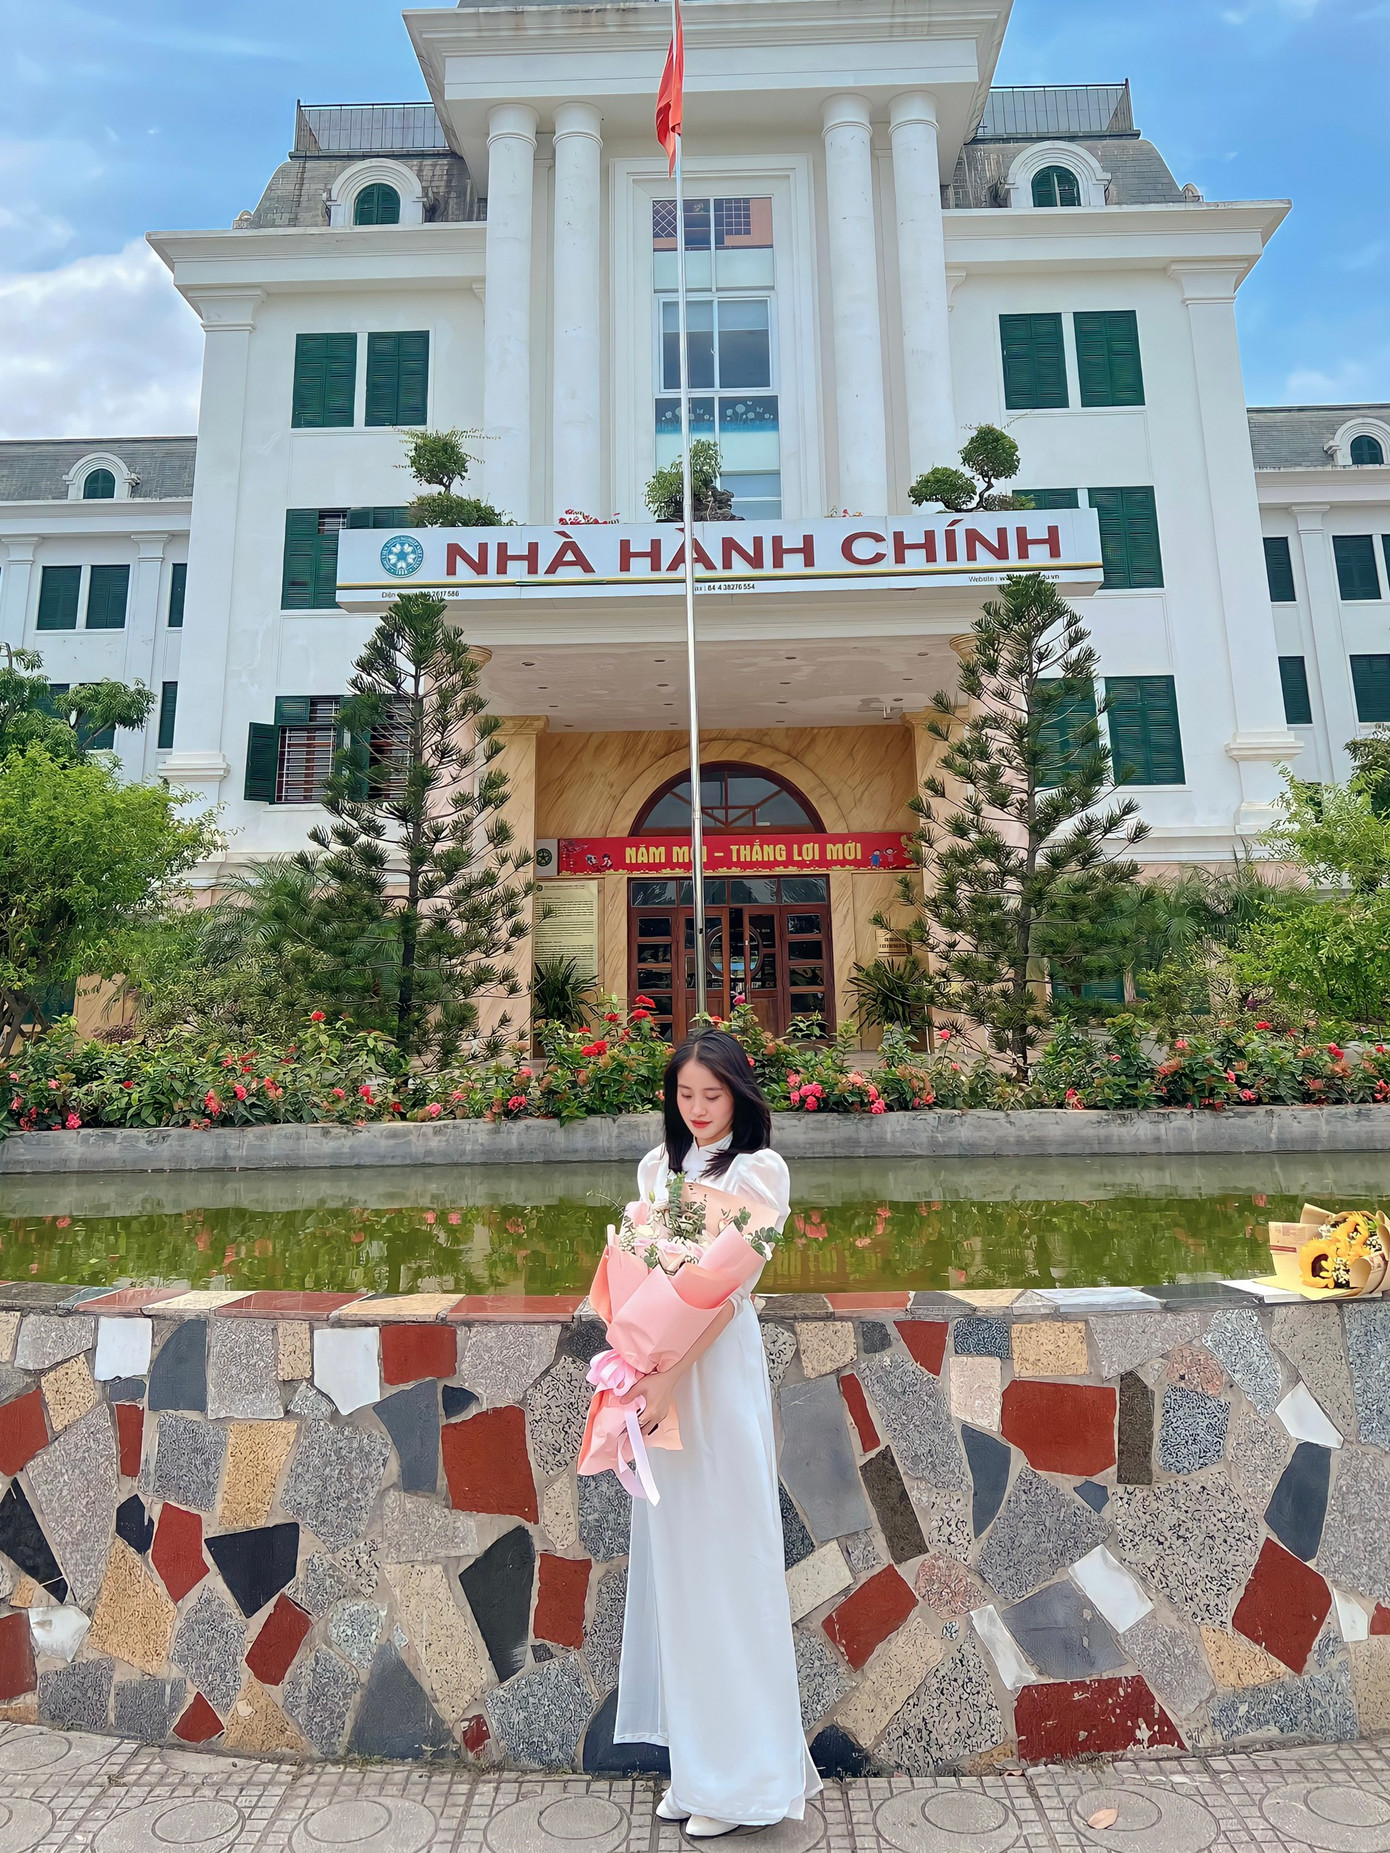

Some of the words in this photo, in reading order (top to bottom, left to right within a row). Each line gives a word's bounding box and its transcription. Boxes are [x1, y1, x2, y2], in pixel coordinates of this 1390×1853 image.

[446, 530, 596, 576] NHÀ
[619, 527, 815, 573] HÀNH
[840, 518, 1061, 566] CHÍNH
[625, 844, 666, 864] NĂM
[672, 845, 707, 863] MI
[730, 839, 787, 862] THẮNG
[793, 842, 819, 864] LỢI
[826, 840, 862, 860] MỚI
